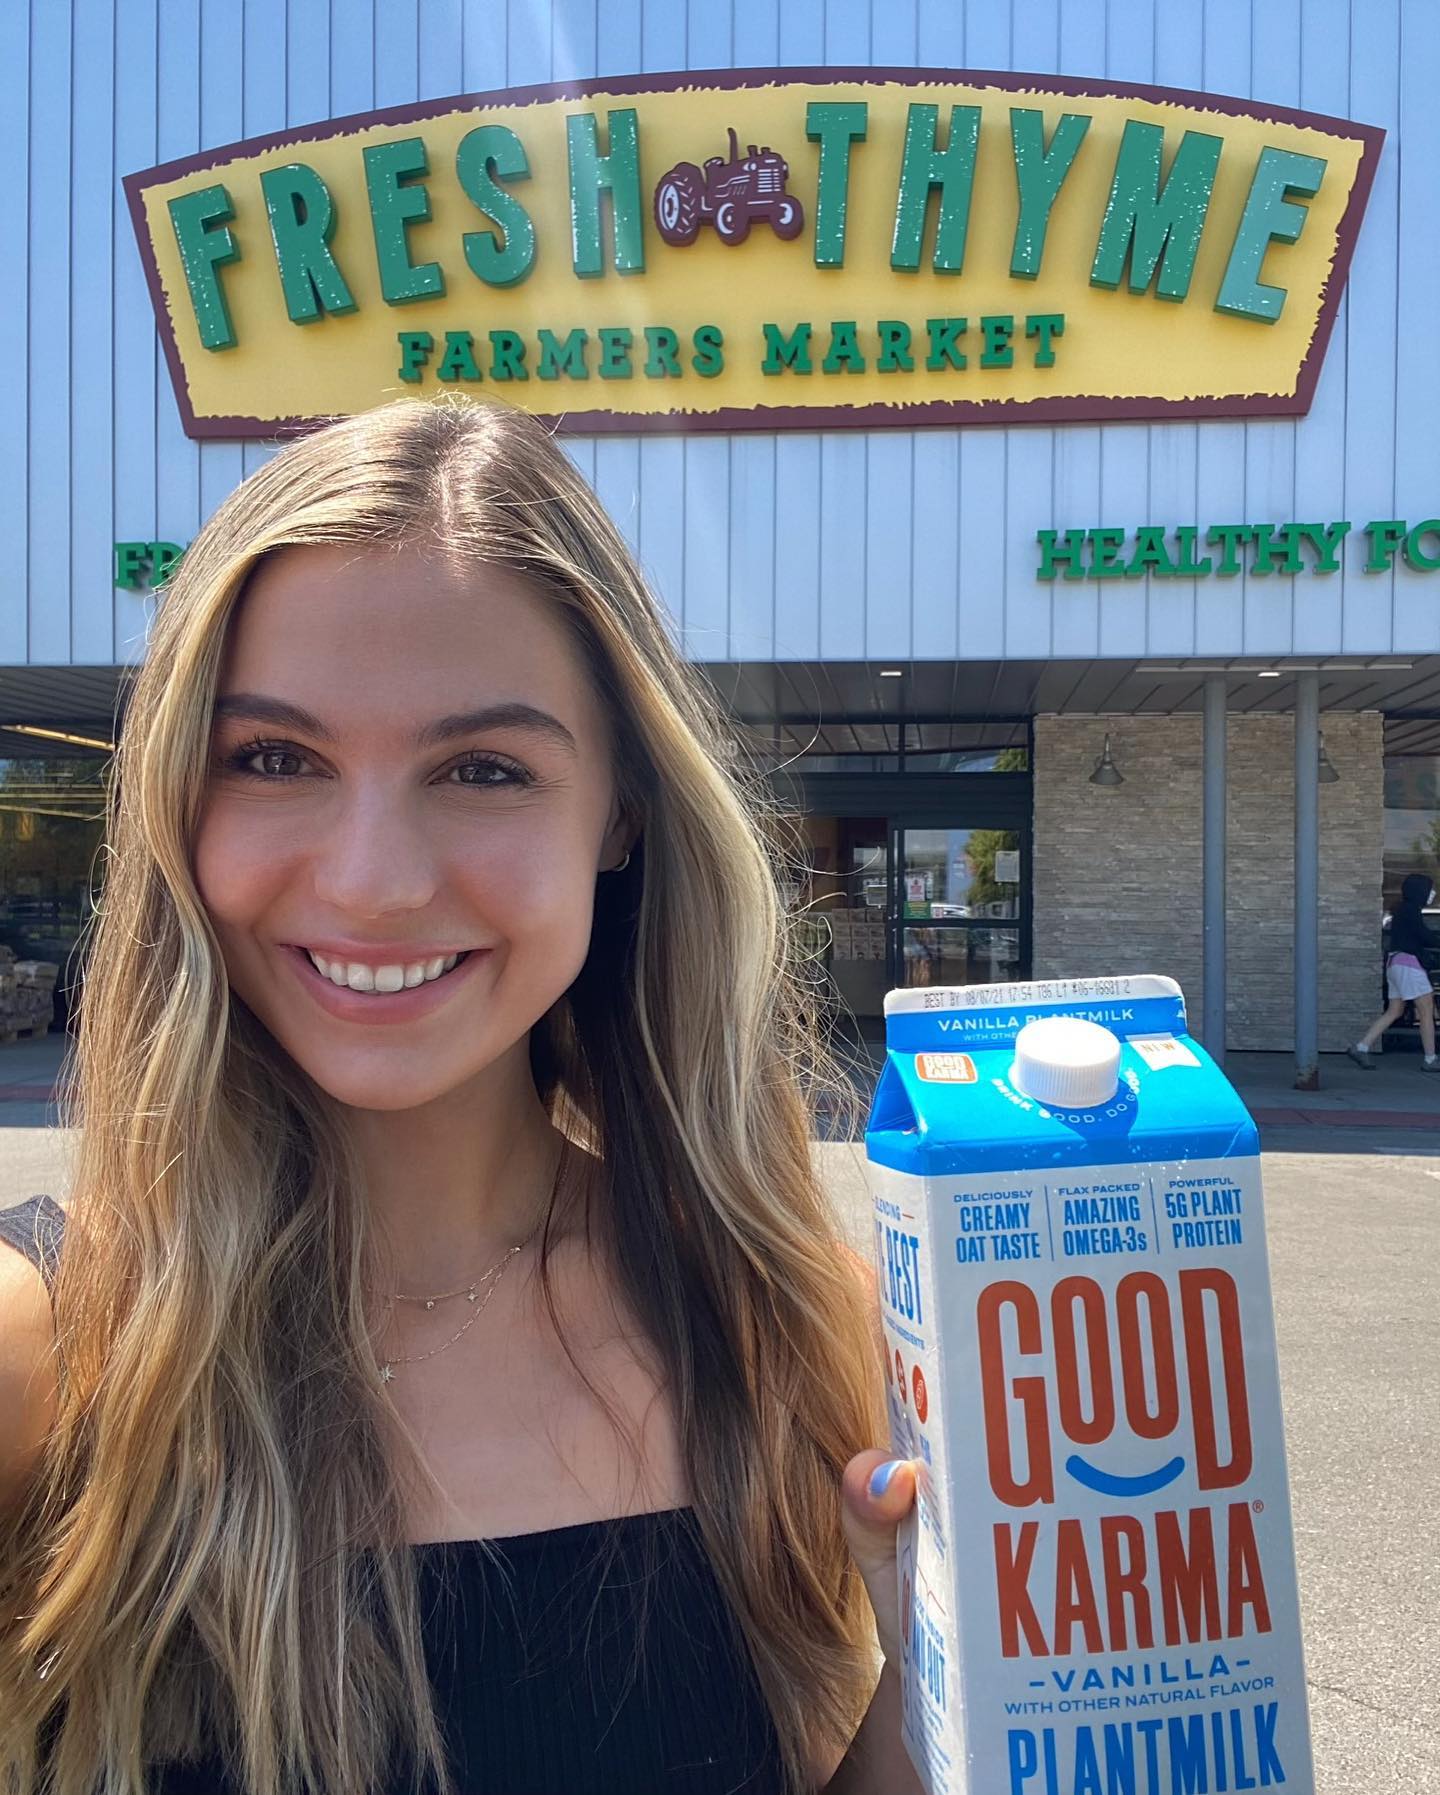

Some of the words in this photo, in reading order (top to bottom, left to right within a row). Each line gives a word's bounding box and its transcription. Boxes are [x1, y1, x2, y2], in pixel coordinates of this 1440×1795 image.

[167, 107, 646, 352] FRESH
[805, 102, 1329, 325] THYME
[398, 325, 724, 383] FARMERS
[761, 313, 1065, 376] MARKET
[1036, 521, 1352, 581] HEALTHY
[924, 991, 945, 1009] BEST
[949, 990, 960, 1007] BY
[938, 1015, 1020, 1033] VANILLA
[1024, 1008, 1135, 1027] PTMILK
[963, 1033, 988, 1042] WITH
[991, 1031, 1017, 1041] OTHE
[1105, 1102, 1128, 1118] DO
[953, 1190, 1033, 1203] DELICIOUSLY
[1058, 1186, 1089, 1196] FLAX
[1093, 1183, 1140, 1194] PACKED
[1169, 1177, 1234, 1188] POWERFUL
[960, 1202, 1030, 1232] CREAMY
[1064, 1195, 1141, 1226] AMAZING
[1164, 1192, 1188, 1218] 5G
[1190, 1188, 1242, 1217] PLANT
[956, 1235, 986, 1263] OAT
[991, 1232, 1041, 1261] TASTE
[1063, 1226, 1147, 1256] OMEGA-3s
[1172, 1218, 1243, 1249] PROTEIN
[886, 1225, 923, 1326] BEST
[976, 1267, 1253, 1508] GOOD
[1004, 1702, 1053, 1715] WITH
[1058, 1696, 1121, 1713] OTHER
[1125, 1687, 1206, 1708] NATURAL
[1210, 1676, 1275, 1698] FLAVOR
[1007, 1701, 1287, 1795] PLANTMILK
